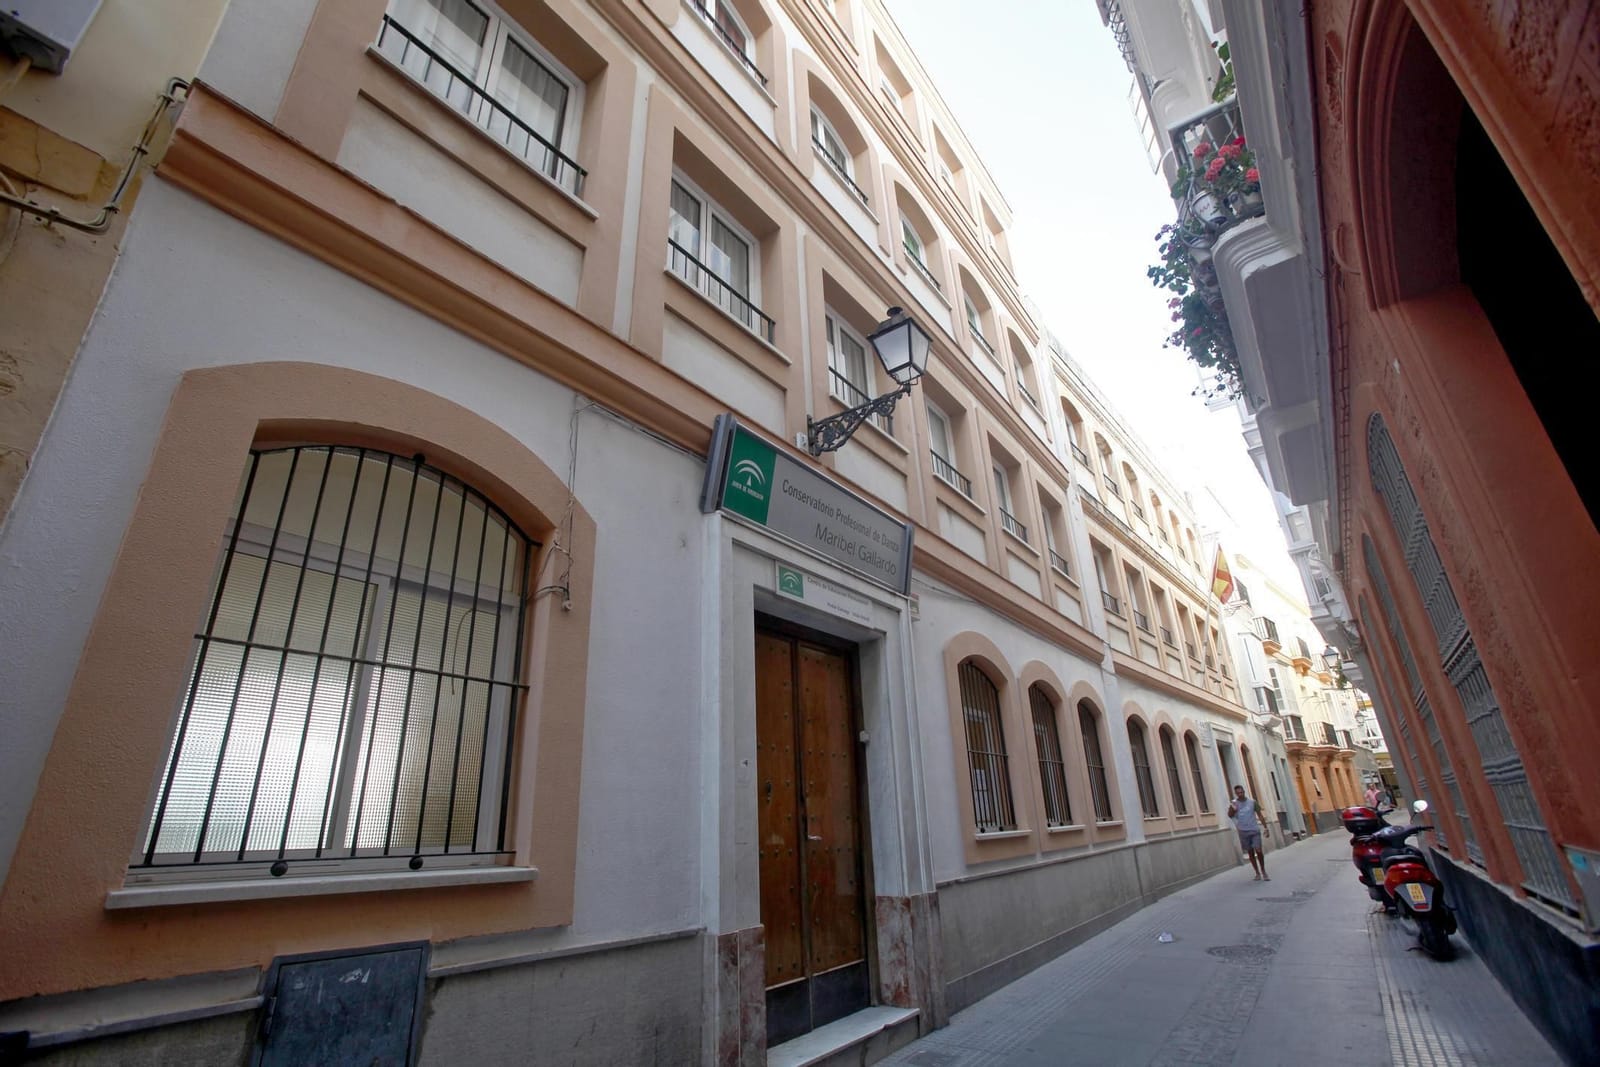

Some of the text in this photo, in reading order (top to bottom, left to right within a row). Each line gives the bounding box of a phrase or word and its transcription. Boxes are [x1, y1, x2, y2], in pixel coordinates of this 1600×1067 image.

[782, 479, 899, 553] Conservatorio Profesional de Danza
[815, 523, 897, 575] Maribel Gallardo
